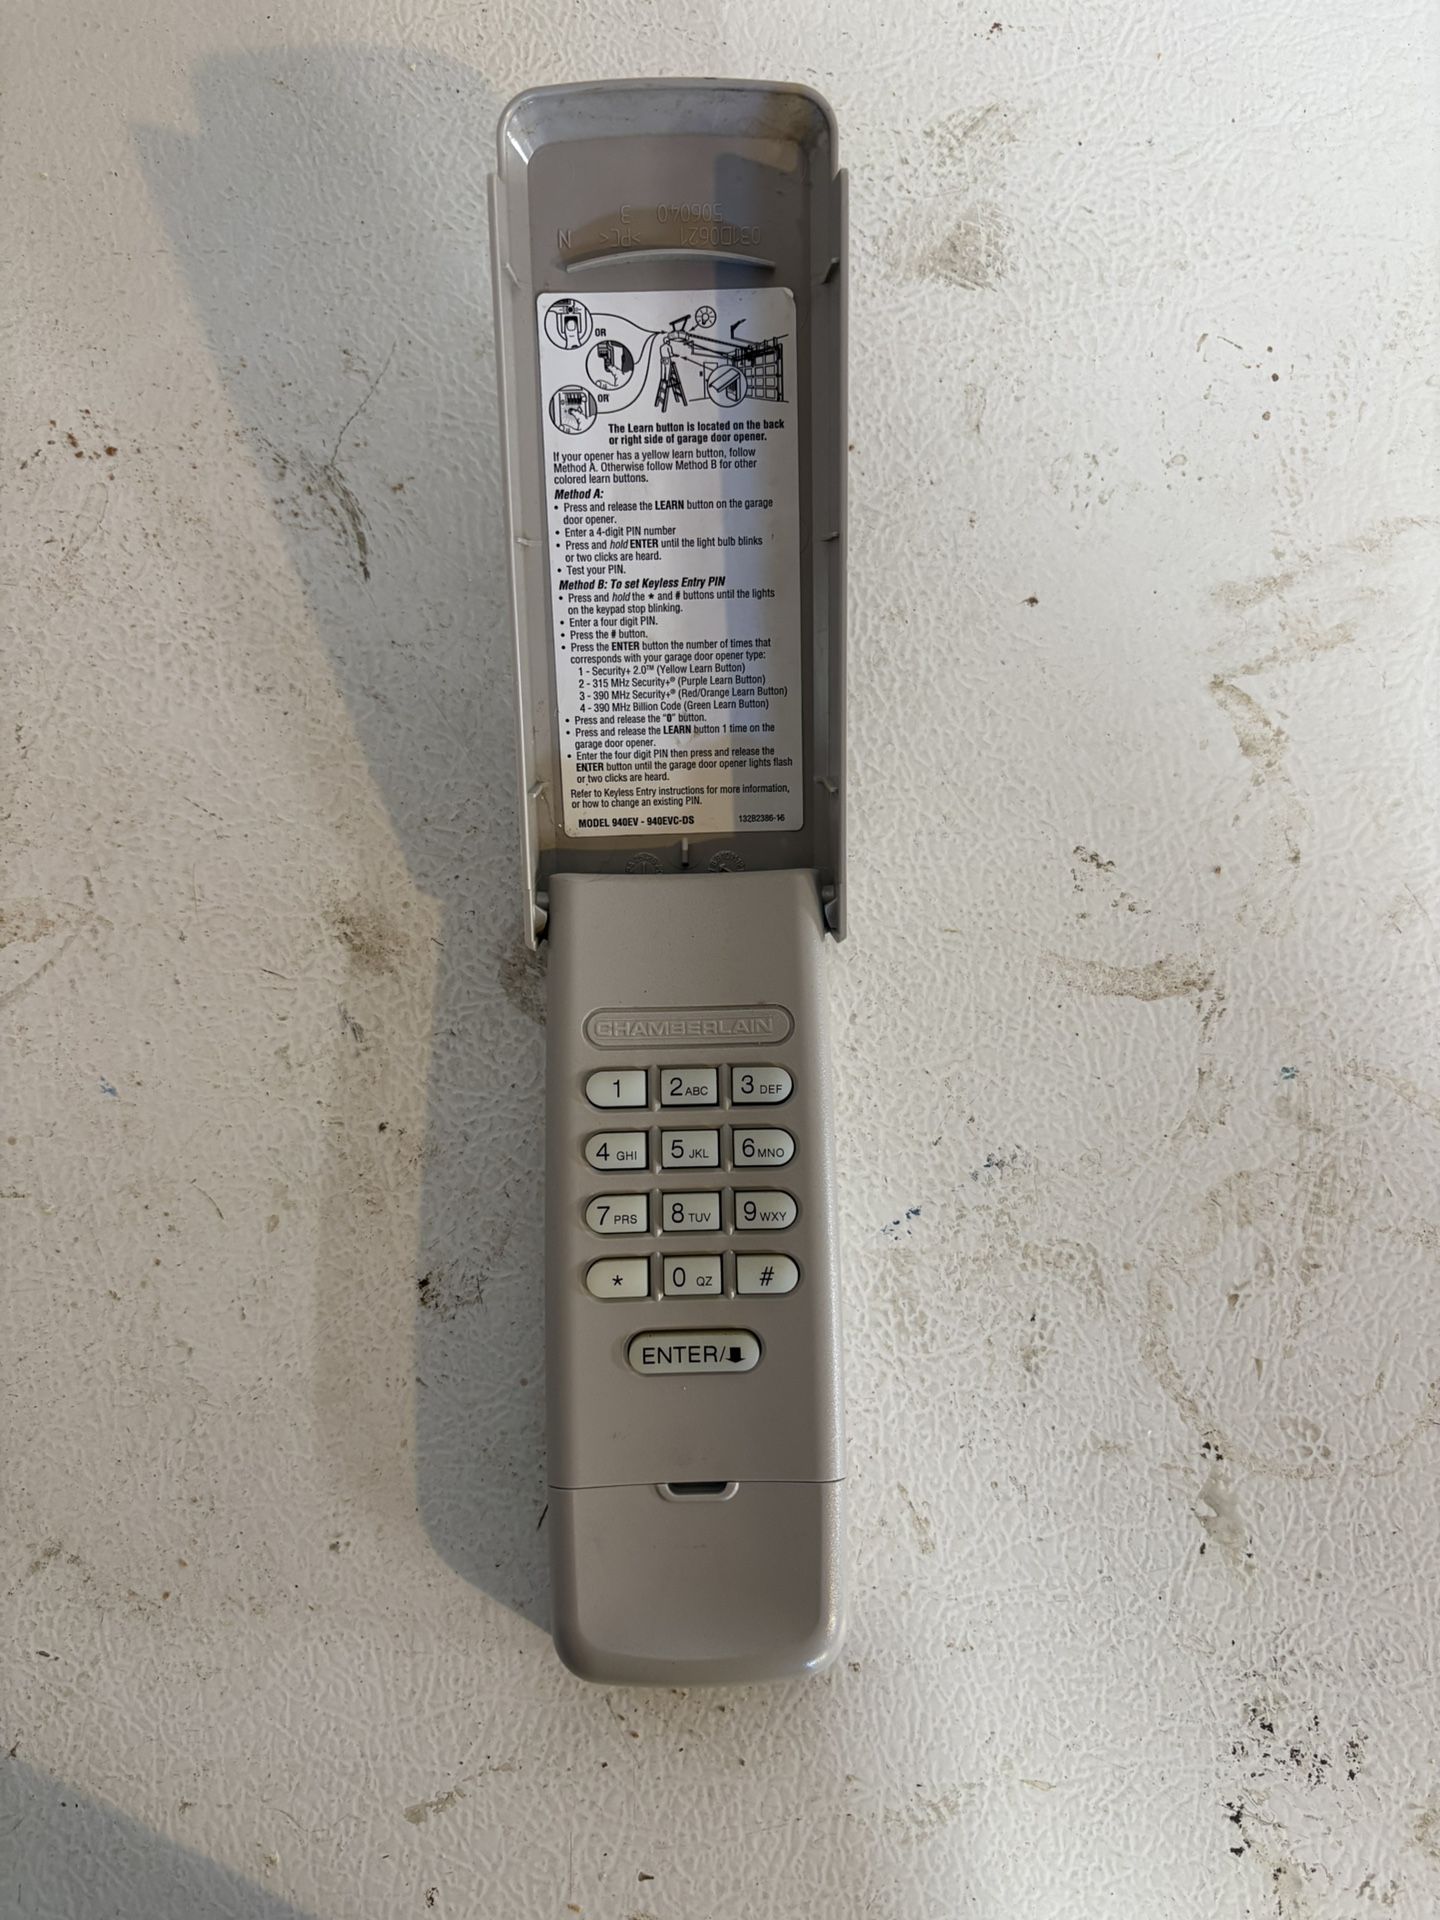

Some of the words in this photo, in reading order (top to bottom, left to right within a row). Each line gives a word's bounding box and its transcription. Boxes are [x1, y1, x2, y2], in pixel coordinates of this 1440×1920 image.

[595, 328, 607, 337] OR
[597, 393, 610, 403] OR
[608, 424, 626, 434] The
[627, 423, 654, 434] Learn
[656, 423, 685, 433] button
[687, 422, 695, 432] is
[697, 422, 731, 432] located
[733, 423, 744, 431] on
[746, 421, 761, 431] the
[763, 420, 785, 430] back
[609, 438, 619, 446] or
[621, 435, 642, 447] right
[644, 435, 664, 445] side
[666, 434, 675, 444] of
[677, 436, 708, 446] garage
[710, 433, 732, 443] door
[733, 434, 767, 445] opener.
[553, 453, 560, 462] If
[561, 454, 582, 464] your
[584, 453, 614, 464] opener
[616, 451, 633, 461] has
[641, 450, 670, 462] yellow
[672, 449, 694, 460] learn
[696, 449, 727, 461] button,
[729, 448, 756, 458] follow
[553, 464, 587, 474] Method
[589, 463, 598, 473] A.
[600, 462, 645, 473] Otherwise
[646, 461, 674, 472] follow
[675, 460, 709, 471] Method
[710, 460, 717, 470] B
[719, 460, 732, 470] for
[734, 459, 758, 469] other
[554, 475, 587, 485] colored
[589, 475, 611, 485] learn
[613, 474, 649, 484] buttons.
[554, 490, 592, 500] Method
[593, 490, 604, 500] A:
[563, 503, 588, 513] Press
[589, 502, 606, 512] and
[608, 502, 638, 512] release
[639, 501, 653, 511] the
[655, 500, 685, 511] LEARN
[686, 500, 714, 510] button
[716, 501, 727, 509] on
[729, 499, 743, 509] the
[744, 500, 774, 511] garage
[563, 515, 583, 526] door
[585, 516, 617, 527] opener.
[564, 528, 587, 538] Enter
[589, 530, 595, 538] a
[596, 527, 624, 539] 4-digit
[626, 527, 642, 537] PIN
[643, 526, 676, 536] number
[565, 556, 575, 564] or
[576, 553, 593, 563] two
[594, 553, 619, 563] clicks
[620, 554, 634, 562] are
[635, 552, 662, 562] heard.
[566, 566, 585, 576] Test
[586, 567, 606, 578] your
[608, 565, 626, 575] PIN.
[558, 581, 596, 591] Method
[597, 580, 608, 590] B:
[609, 580, 623, 590] To
[624, 580, 640, 590] set
[641, 578, 680, 591] Keyless
[680, 578, 706, 590] Entry
[707, 577, 726, 587] PIN
[568, 608, 579, 616] on
[580, 605, 594, 615] the
[596, 605, 626, 617] keypad
[627, 604, 646, 616] stop
[648, 603, 683, 616] blinking.
[569, 618, 592, 628] Enter
[593, 620, 599, 628] a
[600, 618, 618, 628] four
[619, 617, 639, 629] digit
[640, 617, 658, 627] PIN.
[570, 631, 594, 641] Press
[595, 630, 609, 640] the
[611, 630, 617, 640] #
[618, 630, 648, 640] button.
[570, 643, 595, 653] Press
[596, 642, 610, 652] the
[611, 642, 640, 652] ENTER
[642, 641, 669, 651] button
[670, 640, 684, 651] the
[686, 640, 718, 650] number
[720, 639, 729, 649] of
[730, 639, 754, 649] times
[755, 638, 772, 648] that
[580, 704, 586, 713] 4
[593, 703, 610, 713] 390
[612, 703, 631, 713] MHz
[632, 702, 659, 712] Billion
[660, 701, 682, 712] Code
[683, 701, 712, 713] (Green
[713, 700, 737, 710] Learn
[738, 699, 770, 712] Button)
[574, 741, 603, 751] garage
[604, 738, 624, 749] door
[625, 740, 656, 750] opener.
[570, 789, 592, 799] Refer
[593, 788, 603, 798] to
[604, 788, 634, 800] Keyless
[636, 787, 657, 799] Entry
[658, 786, 705, 797] instructions
[706, 786, 718, 796] for
[720, 787, 741, 796] more
[742, 784, 790, 797] information,
[571, 801, 580, 809] or
[582, 799, 600, 809] how
[601, 799, 610, 809] to
[611, 798, 640, 810] change
[641, 800, 652, 808] an
[653, 797, 684, 809] existing
[685, 796, 703, 806] PIN.
[578, 818, 610, 828] MODEL
[612, 817, 639, 828] 940EV
[646, 816, 695, 826] 940EVC-DS
[594, 1015, 774, 1038] CHAMBERLAIN
[613, 1079, 622, 1098] 1
[670, 1077, 683, 1096] 2
[685, 1085, 709, 1096] ABC
[741, 1075, 754, 1094] 3
[760, 1084, 783, 1094] DEF
[596, 1142, 610, 1161] 4
[616, 1150, 638, 1161] GHI
[671, 1140, 684, 1159] 5
[688, 1148, 709, 1159] JKL
[742, 1138, 755, 1158] 6
[757, 1147, 785, 1158] MNO
[596, 1206, 610, 1225] 7
[614, 1214, 638, 1225] PRS
[671, 1203, 684, 1223] 8
[688, 1212, 712, 1223] TUV
[743, 1201, 757, 1221] 9
[759, 1211, 787, 1222] WXY
[672, 1267, 686, 1287] 0
[696, 1276, 713, 1287] QZ
[759, 1267, 775, 1286] #
